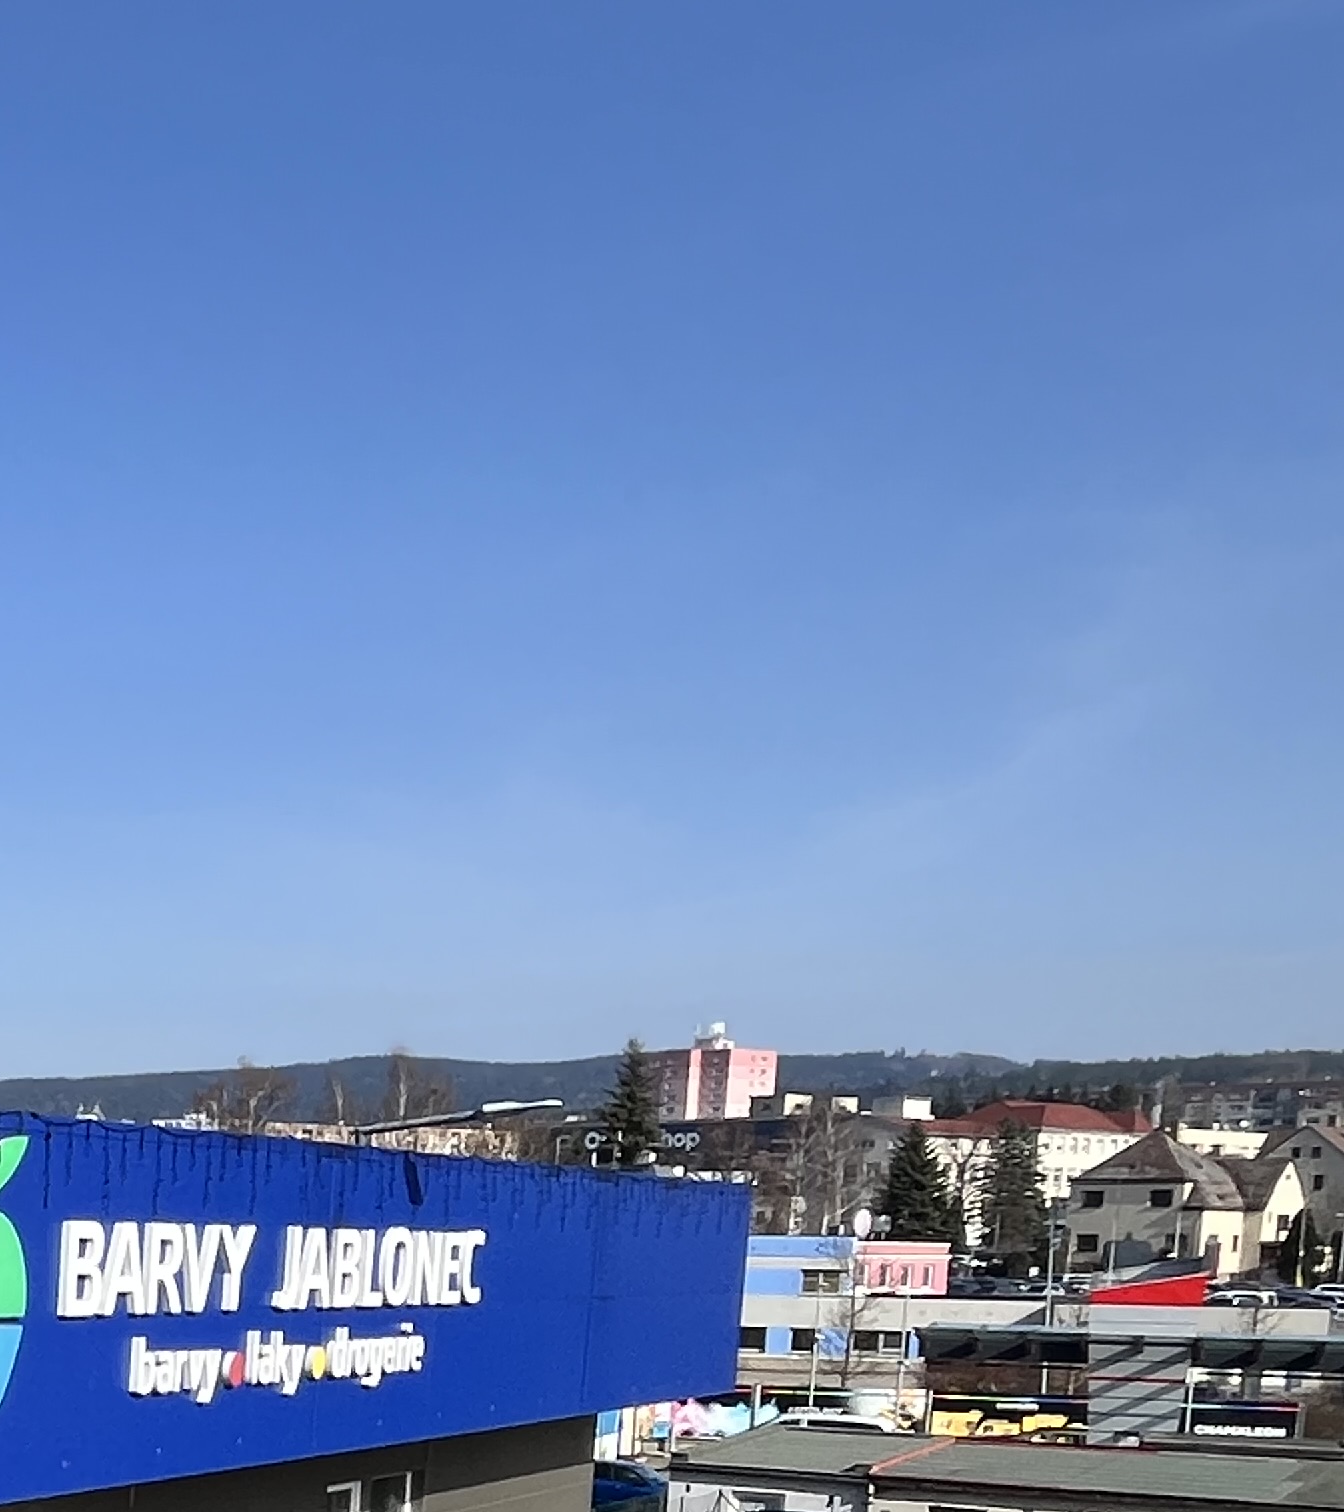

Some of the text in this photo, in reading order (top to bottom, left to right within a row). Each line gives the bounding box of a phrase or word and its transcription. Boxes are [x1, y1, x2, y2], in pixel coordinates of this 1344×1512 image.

[56, 1219, 486, 1318] BARVY JABLONEC
[128, 1322, 425, 1404] barvy laky drogerie
